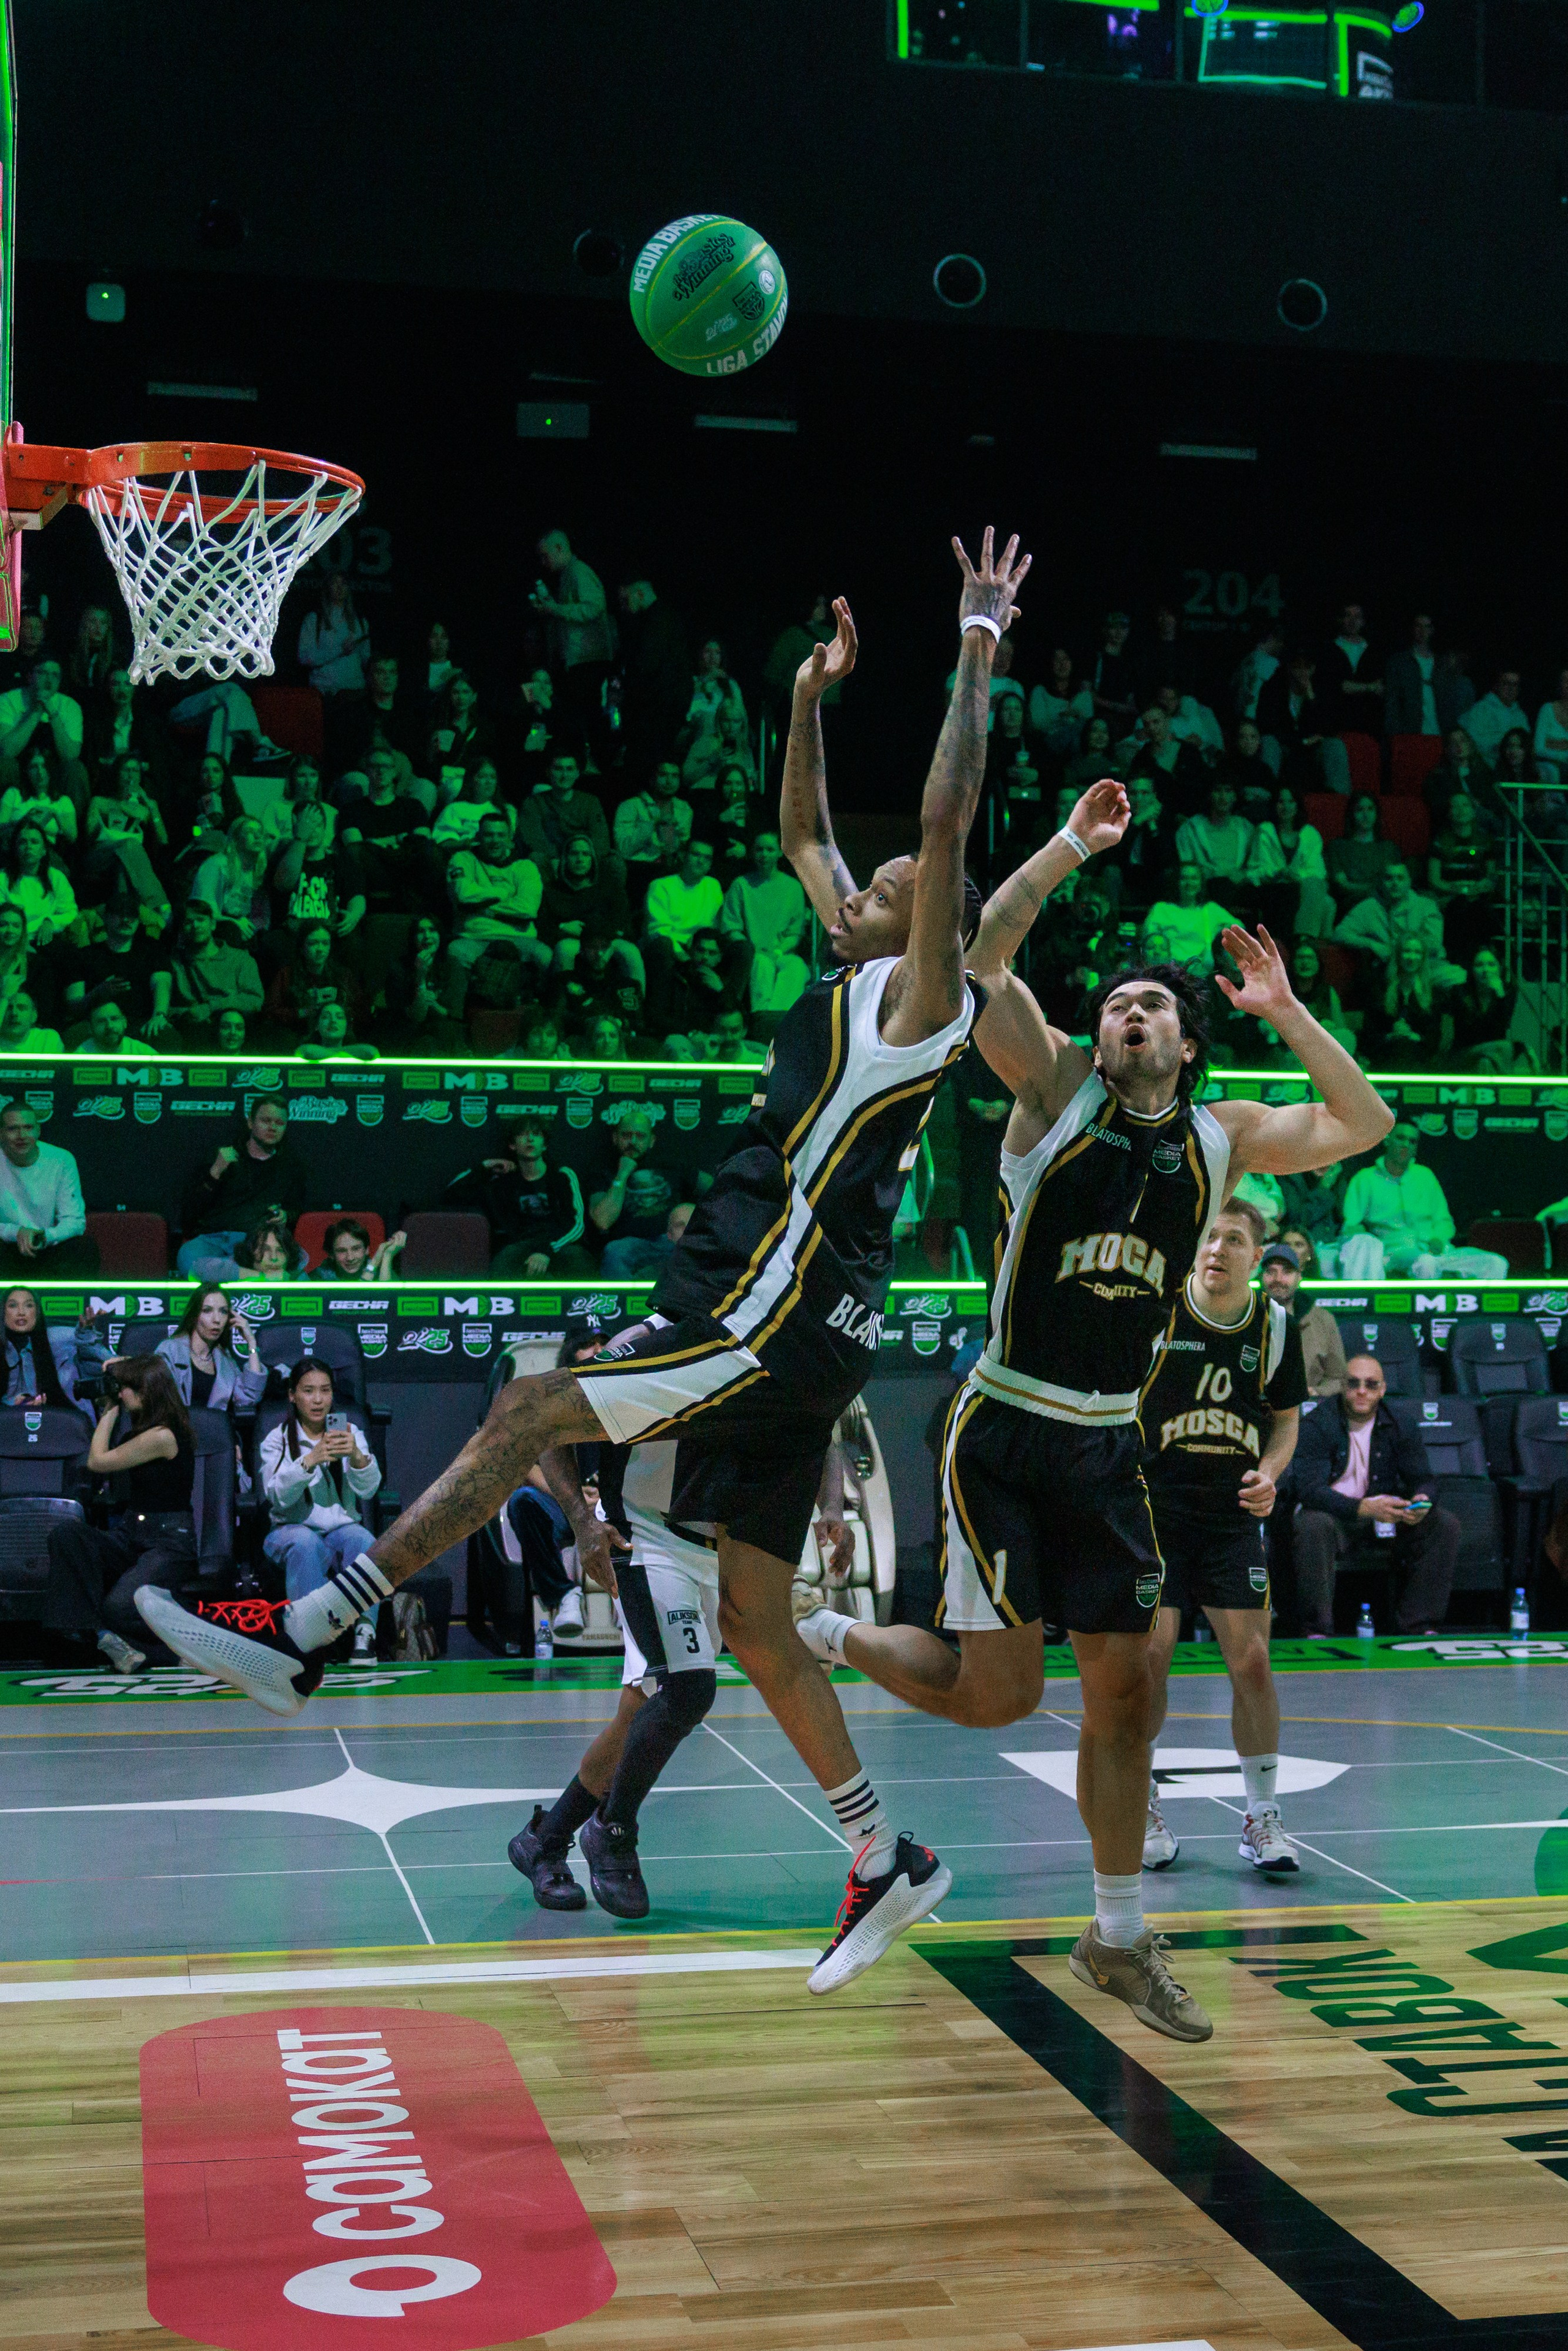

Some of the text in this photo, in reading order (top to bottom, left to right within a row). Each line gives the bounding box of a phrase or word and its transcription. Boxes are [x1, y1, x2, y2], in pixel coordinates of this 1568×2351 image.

[633, 243, 669, 293] MEDIA
[707, 350, 747, 374] LIGA
[752, 290, 788, 361] STAVO
[1182, 569, 1286, 617] 204
[1196, 1362, 1232, 1403] 10
[1160, 1407, 1261, 1459] MOSCA
[682, 1627, 700, 1654] 3
